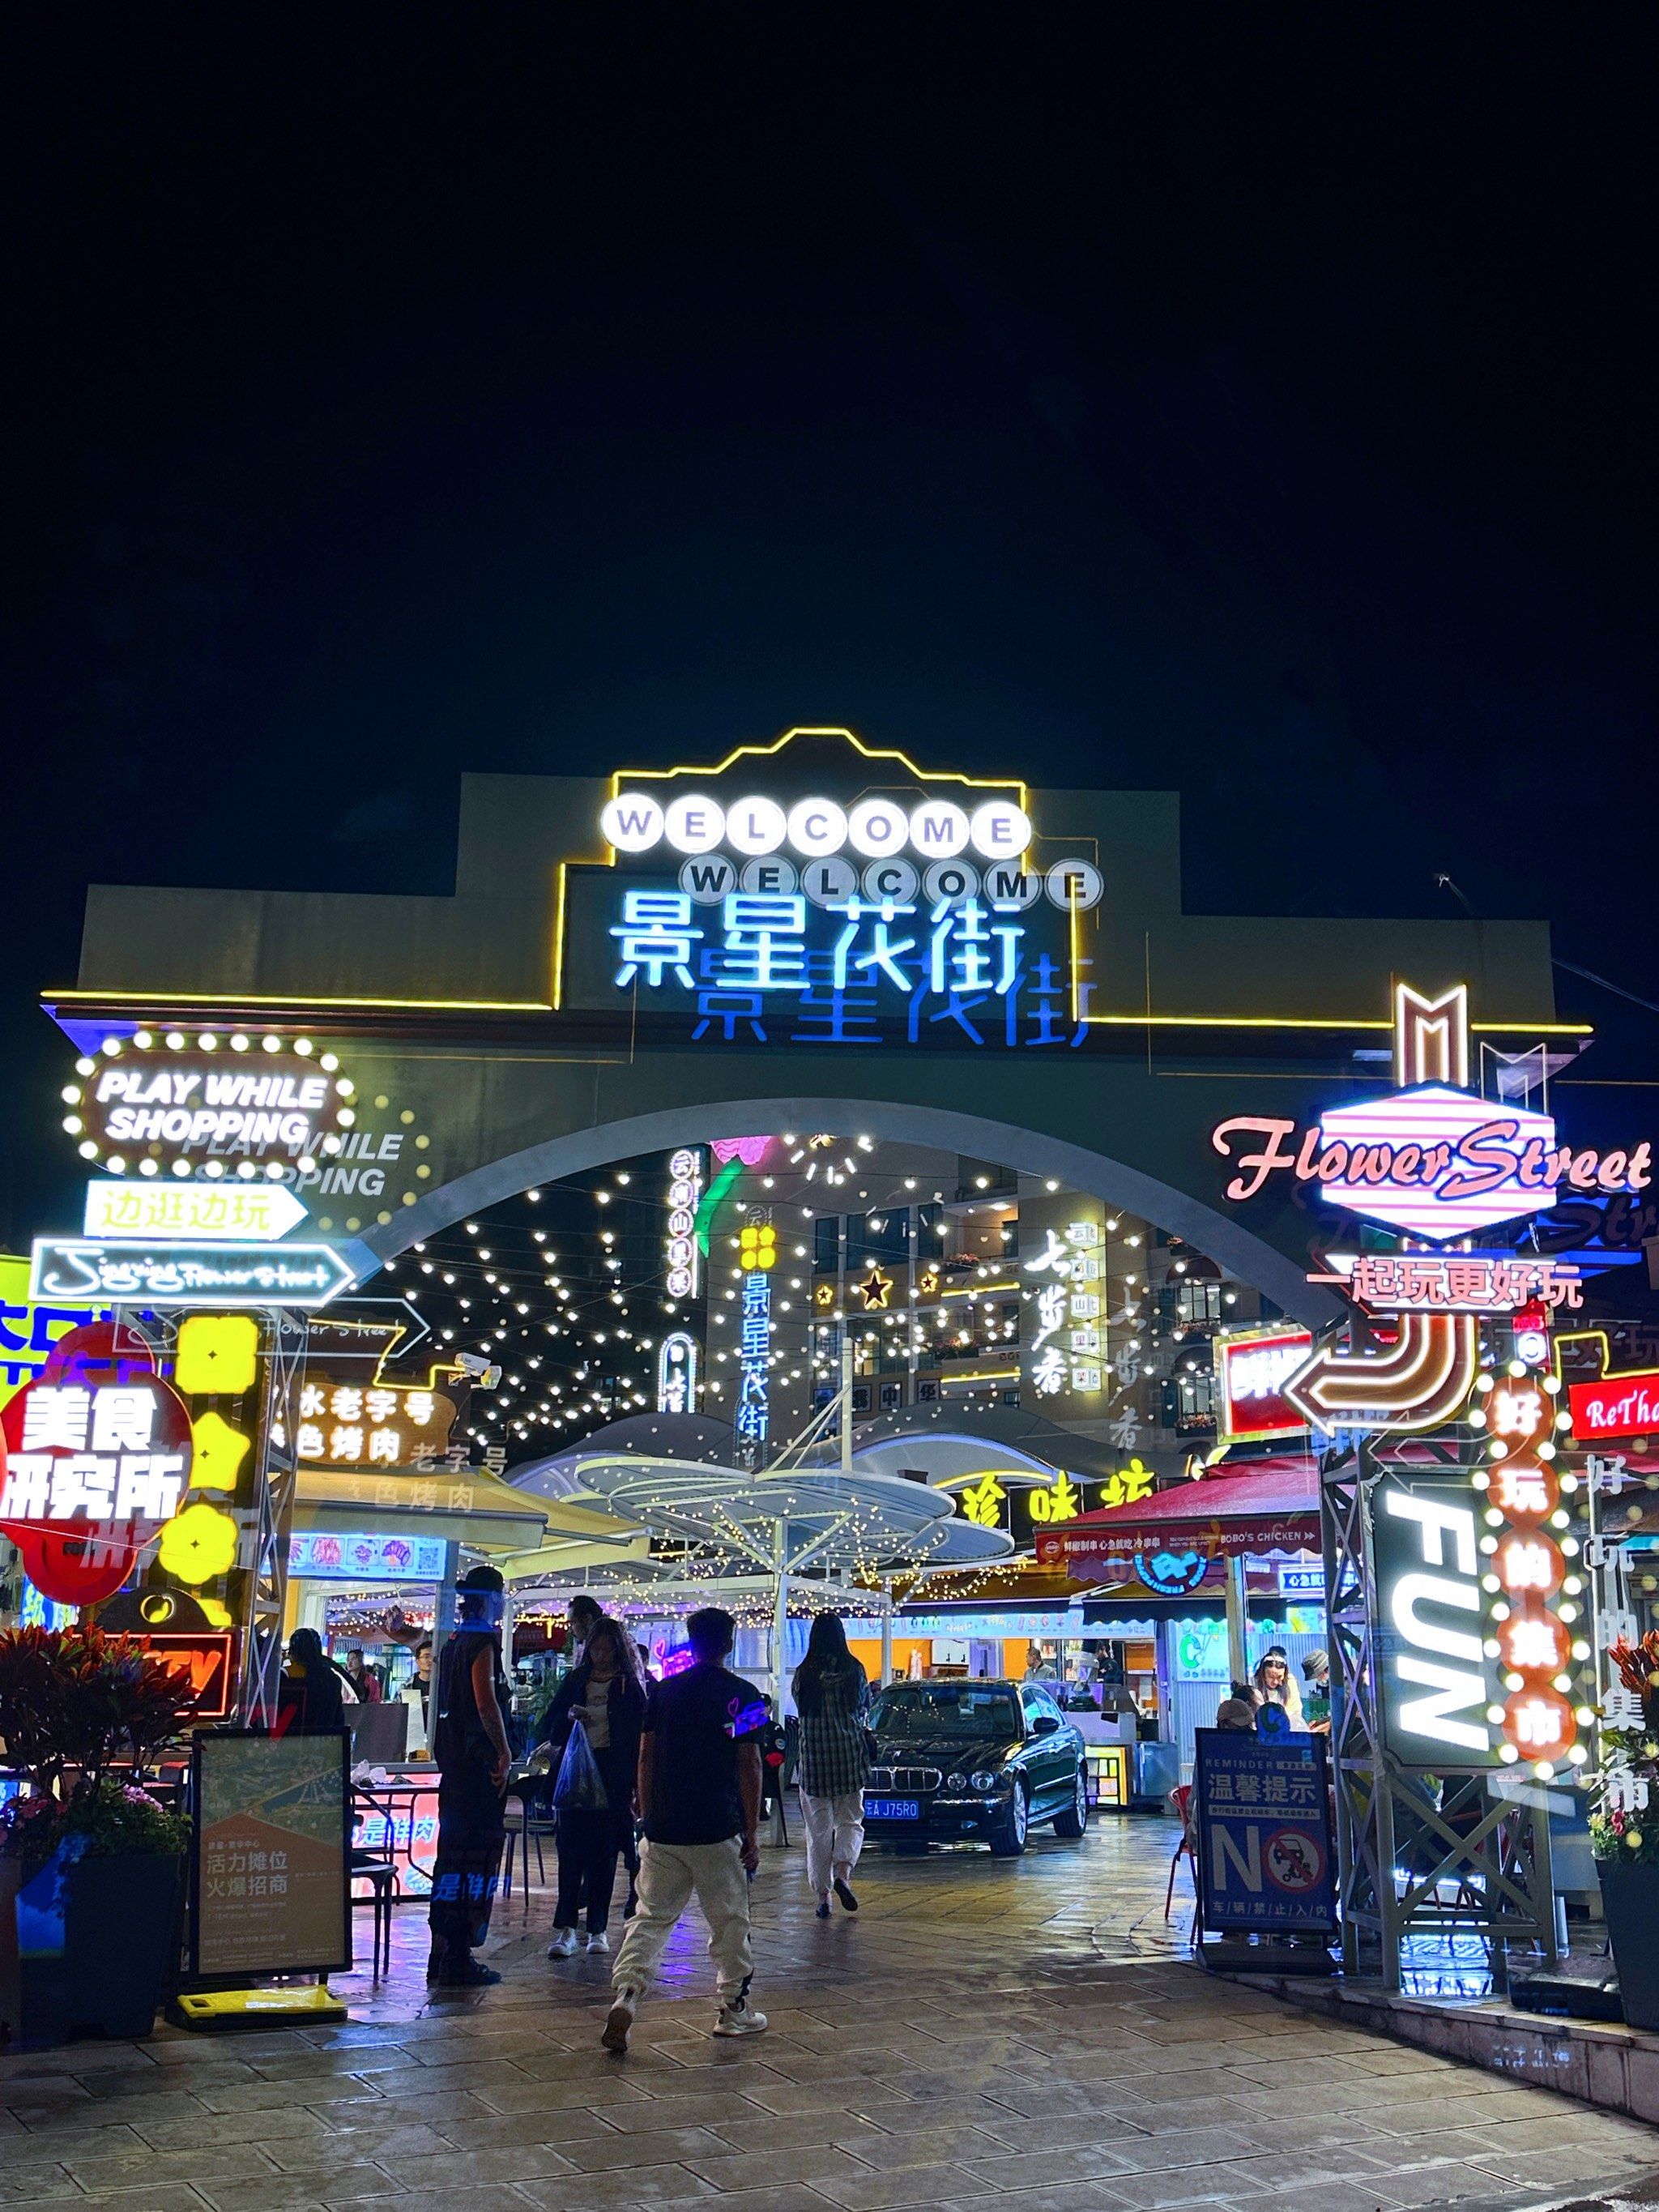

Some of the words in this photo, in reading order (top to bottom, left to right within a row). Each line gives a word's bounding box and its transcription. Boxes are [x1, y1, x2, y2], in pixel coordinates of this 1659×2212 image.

[615, 808, 1014, 845] WELCOME
[689, 864, 1088, 900] WELCOME
[608, 890, 1026, 995] 景星花街
[96, 1073, 201, 1105] PLAY
[204, 1076, 328, 1108] WHILE
[105, 1108, 310, 1143] SHOPPING
[1212, 1117, 1450, 1201] Flower
[1435, 1118, 1652, 1201] Street
[101, 1189, 271, 1231] 边逛边玩
[1305, 1257, 1584, 1310] 一起玩更好玩
[740, 1271, 770, 1441] 景星花街
[22, 1386, 158, 1452] 美食
[0, 1454, 184, 1519] 研究所
[962, 1458, 1157, 1529] 珍味坛
[1221, 1531, 1255, 1544] BOBO'S
[1257, 1531, 1301, 1543] CHICKEN
[1495, 1390, 1563, 1745] 好玩的集市
[1386, 1490, 1491, 1753] FUN
[1205, 1757, 1274, 1770] REMINDER
[1209, 1773, 1316, 1804] 温馨提示
[206, 1850, 288, 1874] 活力摊位
[206, 1874, 288, 1898] 火爆招商
